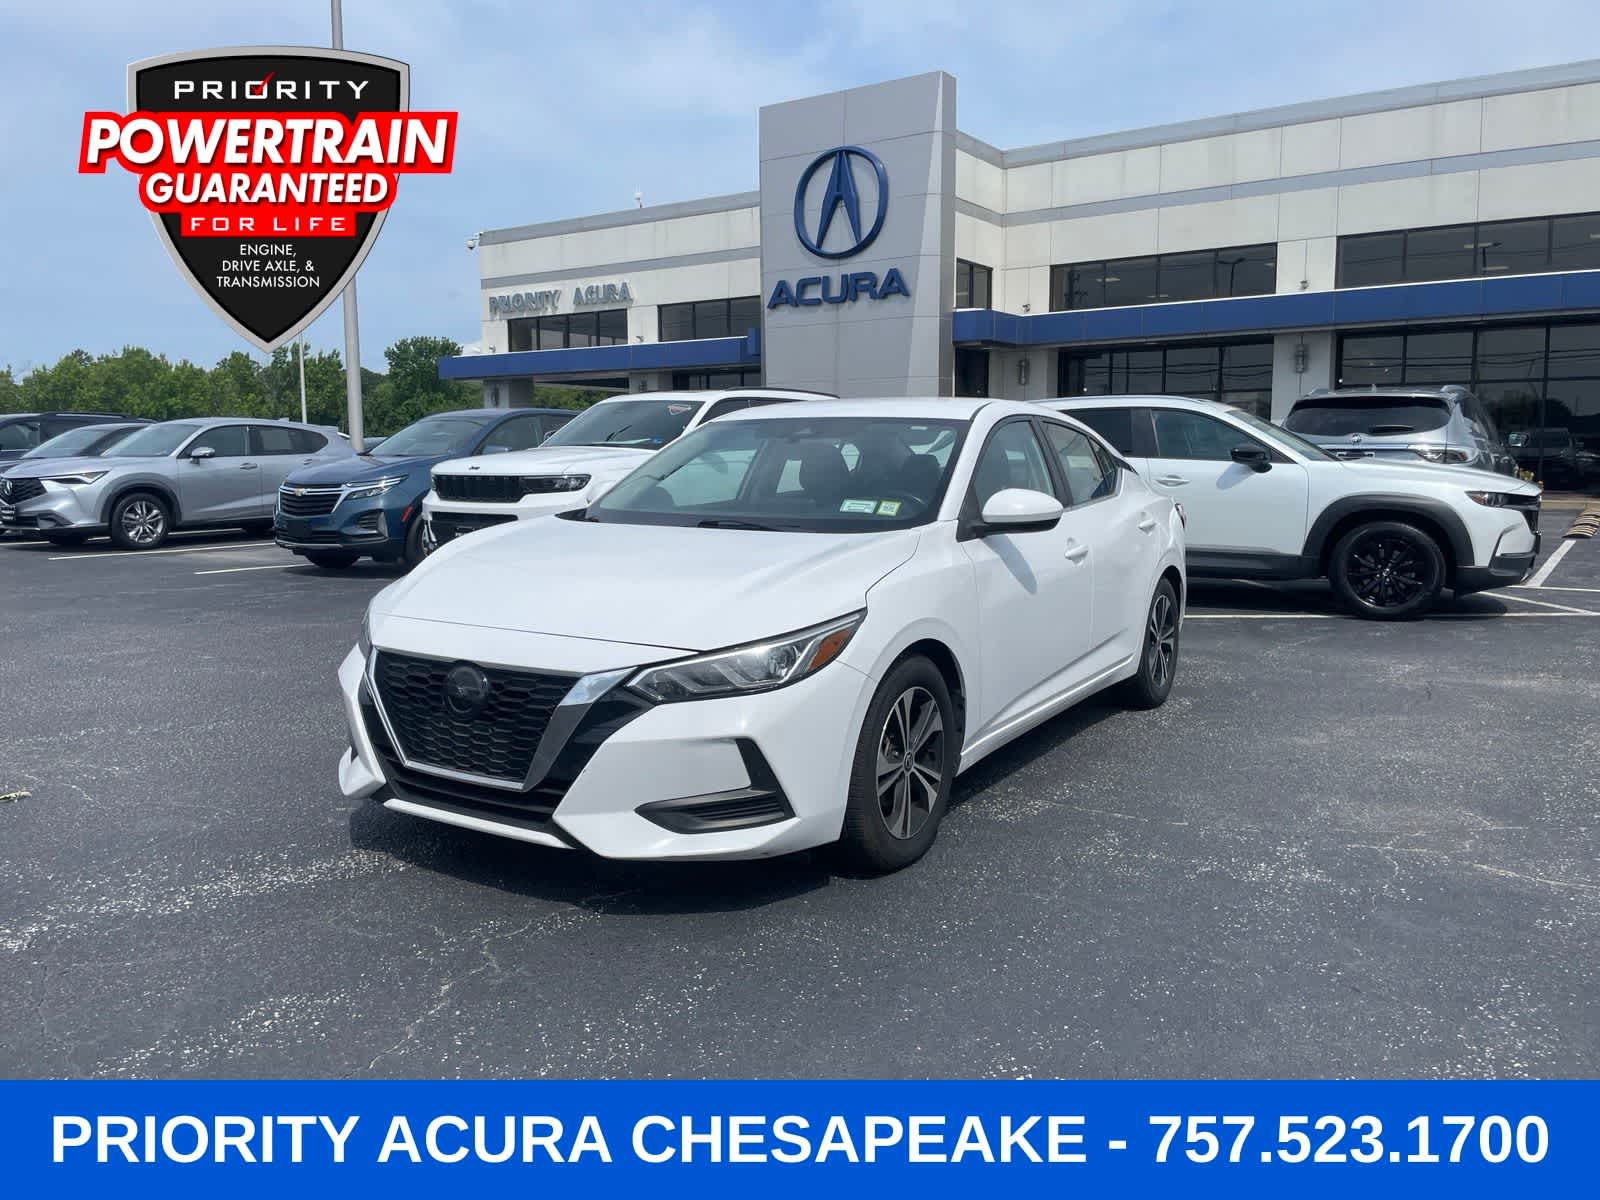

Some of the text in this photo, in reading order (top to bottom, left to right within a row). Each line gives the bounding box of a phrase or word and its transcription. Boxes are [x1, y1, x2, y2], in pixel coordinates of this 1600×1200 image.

[489, 282, 633, 316] PRIORITY ACURA
[767, 267, 911, 309] ACURA
